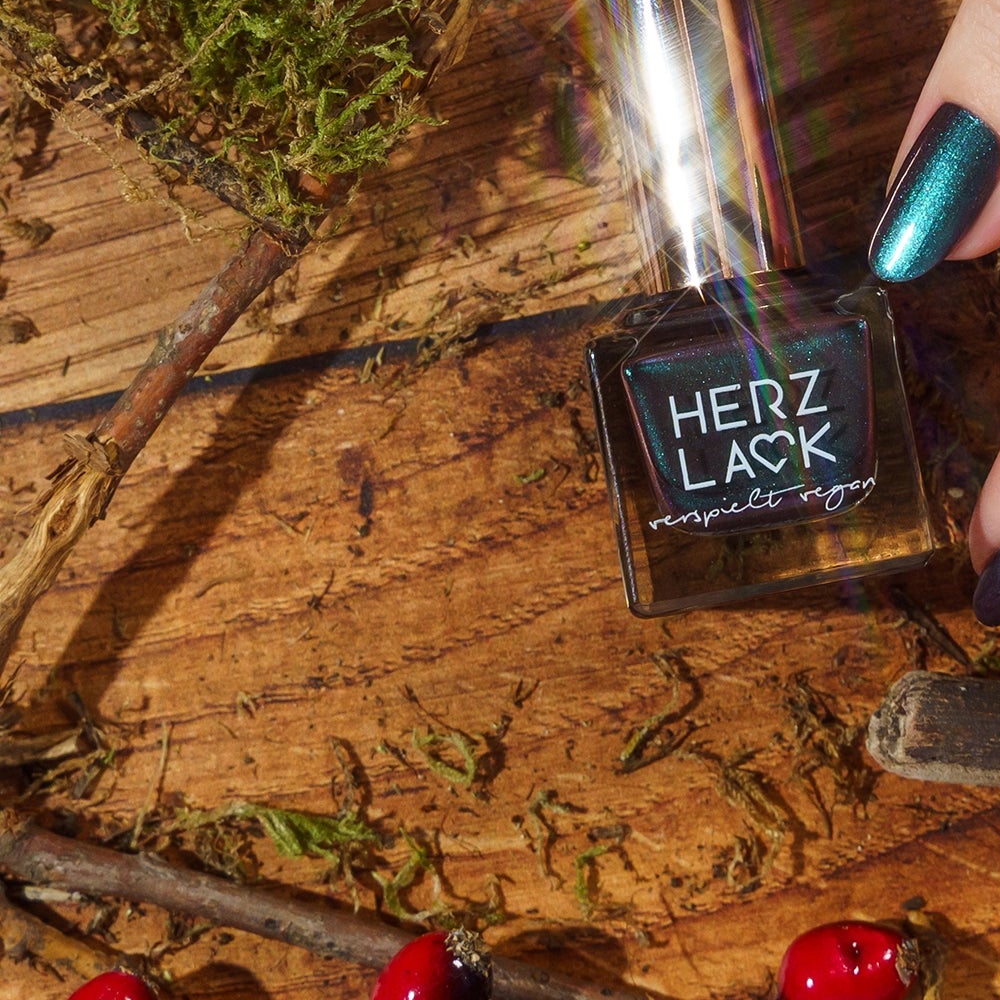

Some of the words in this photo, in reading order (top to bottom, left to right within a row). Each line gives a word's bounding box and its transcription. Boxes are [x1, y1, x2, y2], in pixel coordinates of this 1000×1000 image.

[668, 369, 828, 438] HERZ
[649, 484, 805, 530] verspielt
[799, 476, 876, 510] vegan
